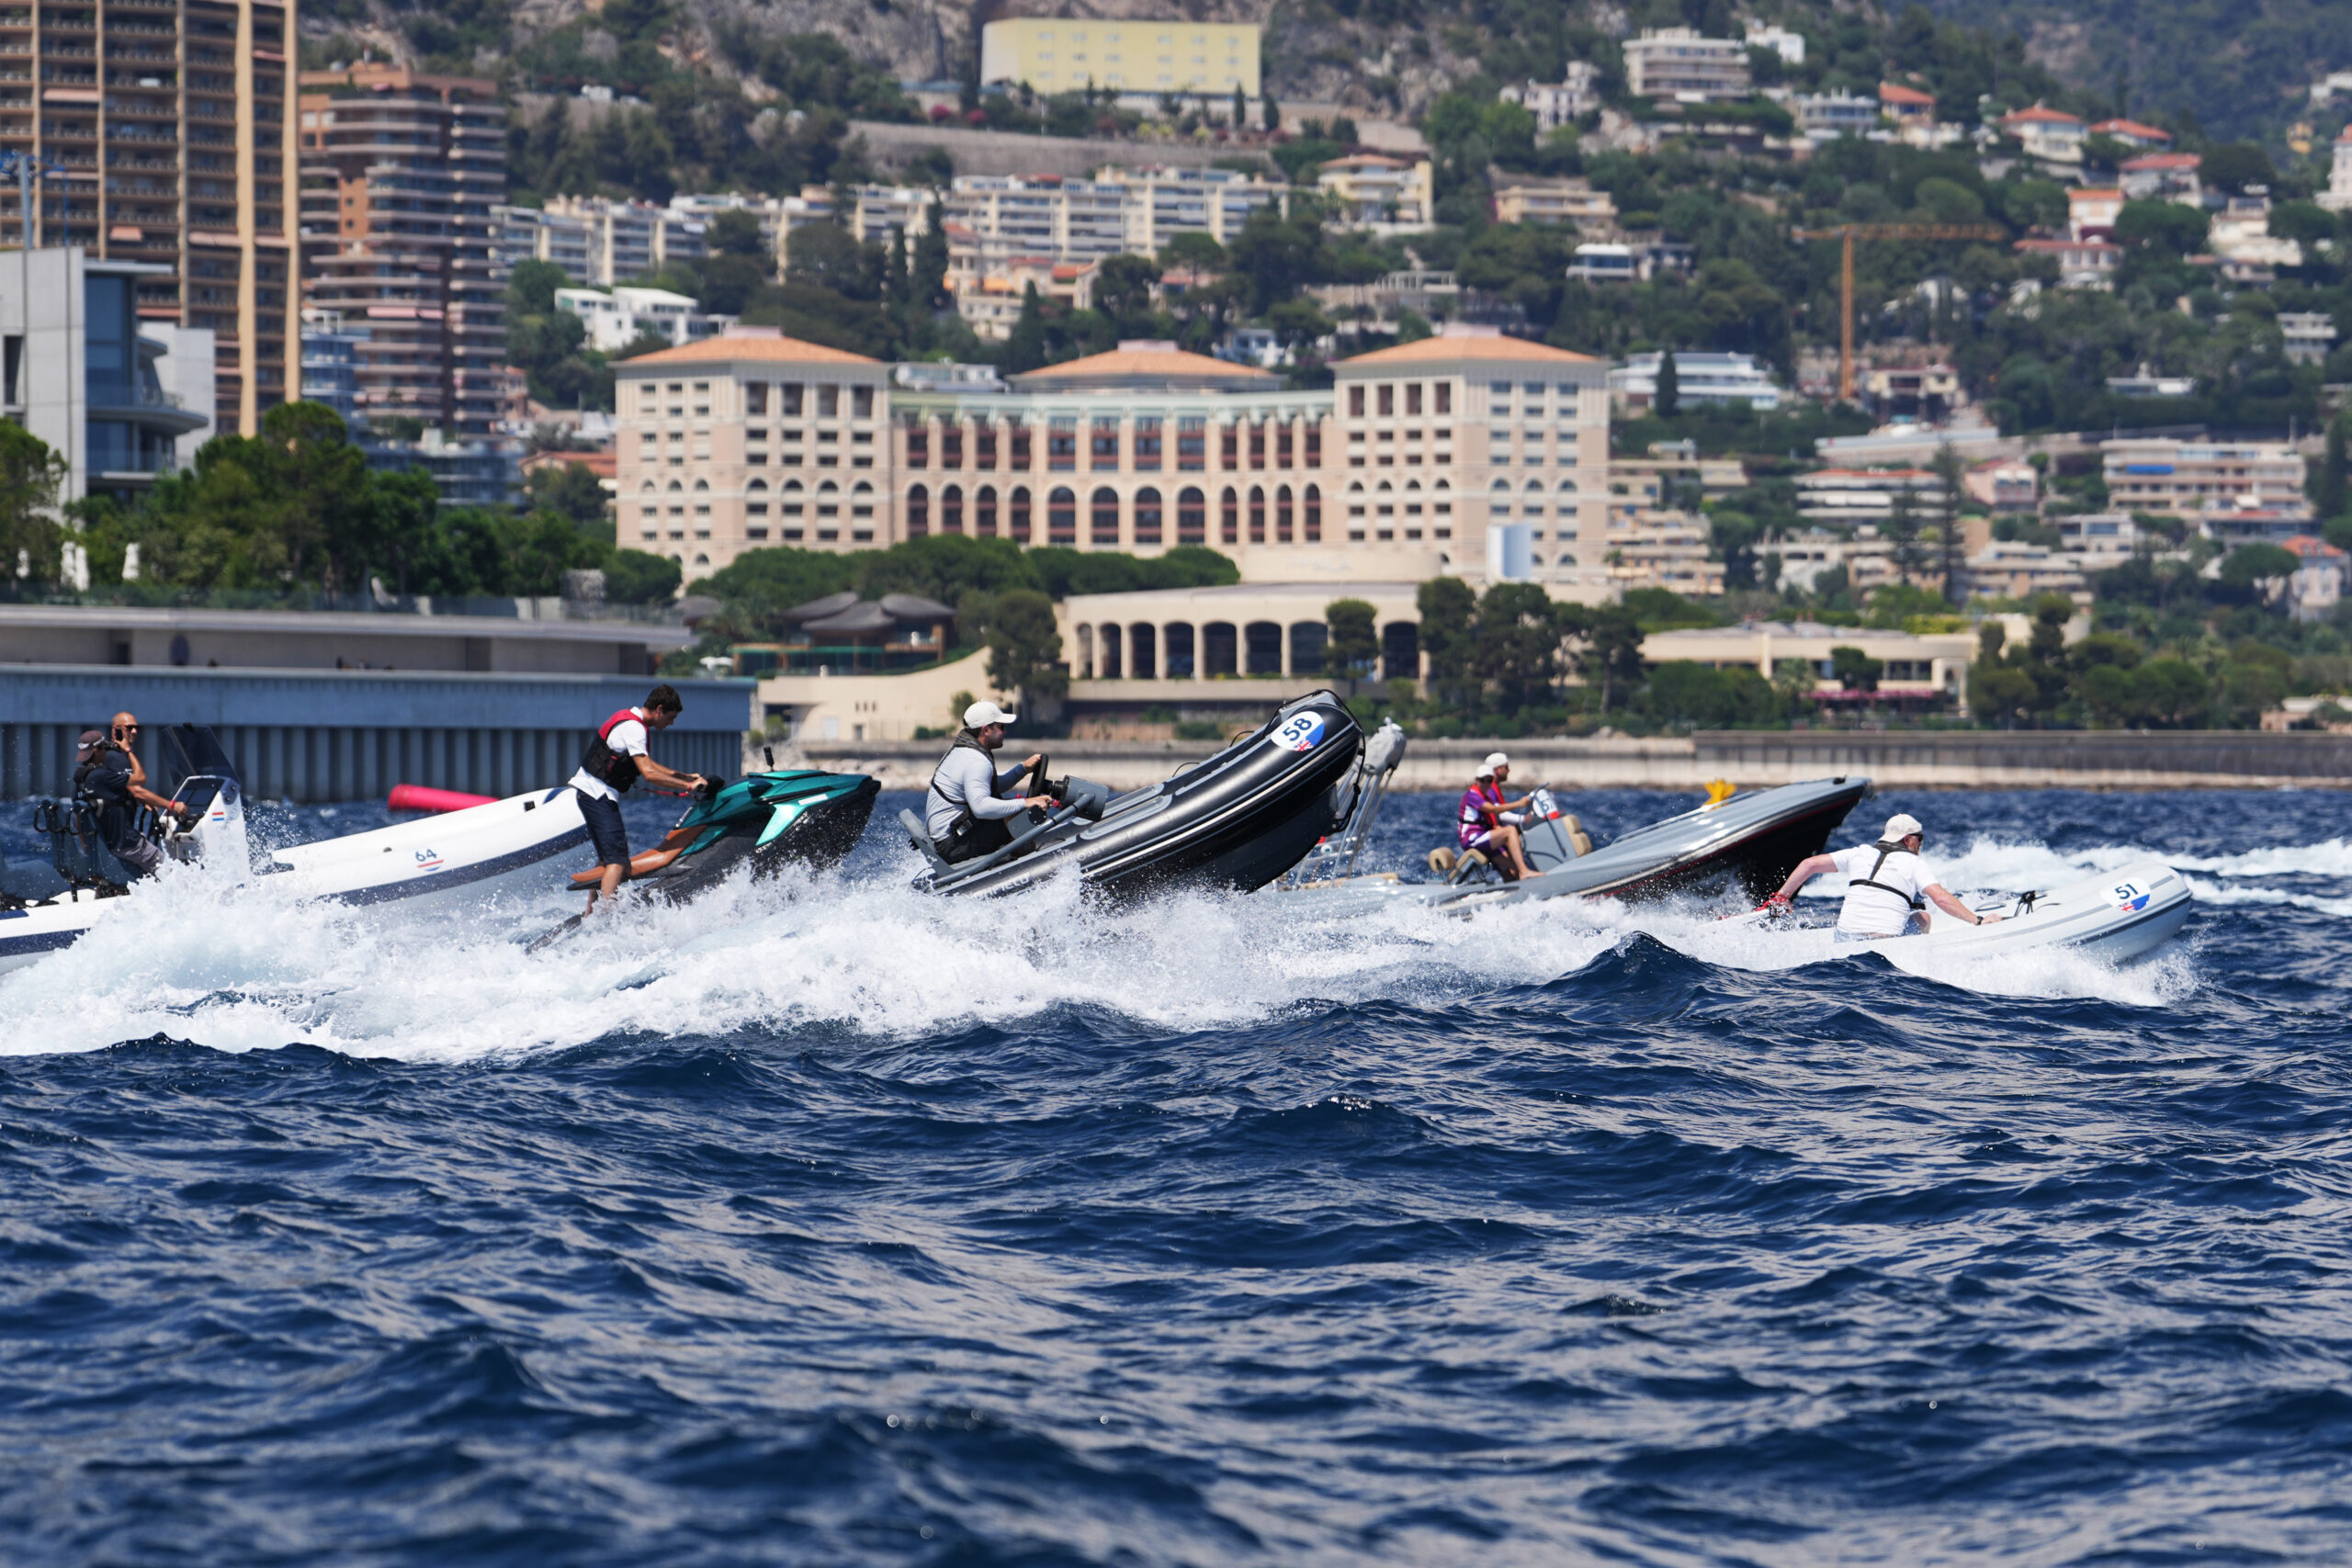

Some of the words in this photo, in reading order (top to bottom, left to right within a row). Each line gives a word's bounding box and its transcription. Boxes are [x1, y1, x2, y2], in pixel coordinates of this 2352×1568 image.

[1283, 718, 1312, 741] 58
[415, 849, 437, 862] 64
[2115, 883, 2139, 899] 51
